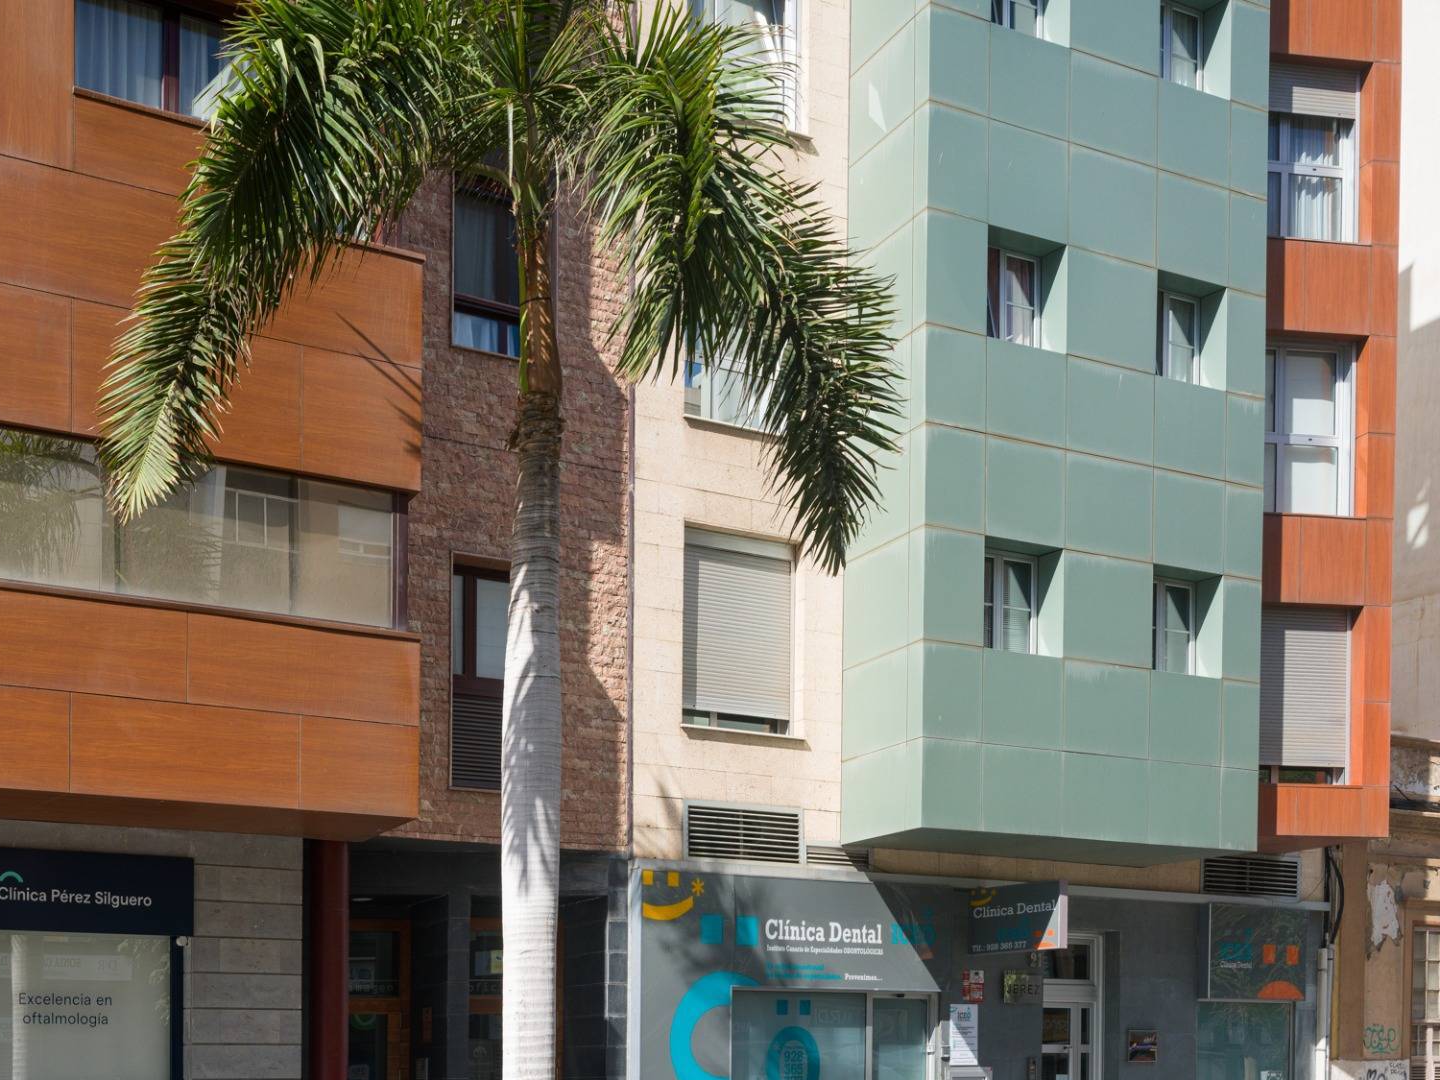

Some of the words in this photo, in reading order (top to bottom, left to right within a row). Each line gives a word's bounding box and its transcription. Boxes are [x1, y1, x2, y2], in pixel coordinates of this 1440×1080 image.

[51, 887, 91, 905] Pérez
[94, 890, 153, 909] Silguero
[973, 905, 1015, 919] Clínica
[1017, 899, 1057, 915] Dental
[765, 918, 826, 942] Clínica
[828, 922, 883, 945] Dental
[1006, 984, 1041, 995] JEREZ
[18, 992, 92, 1007] Excelencia
[96, 994, 113, 1007] en
[22, 1010, 110, 1028] oftalmología
[783, 1050, 803, 1063] 928
